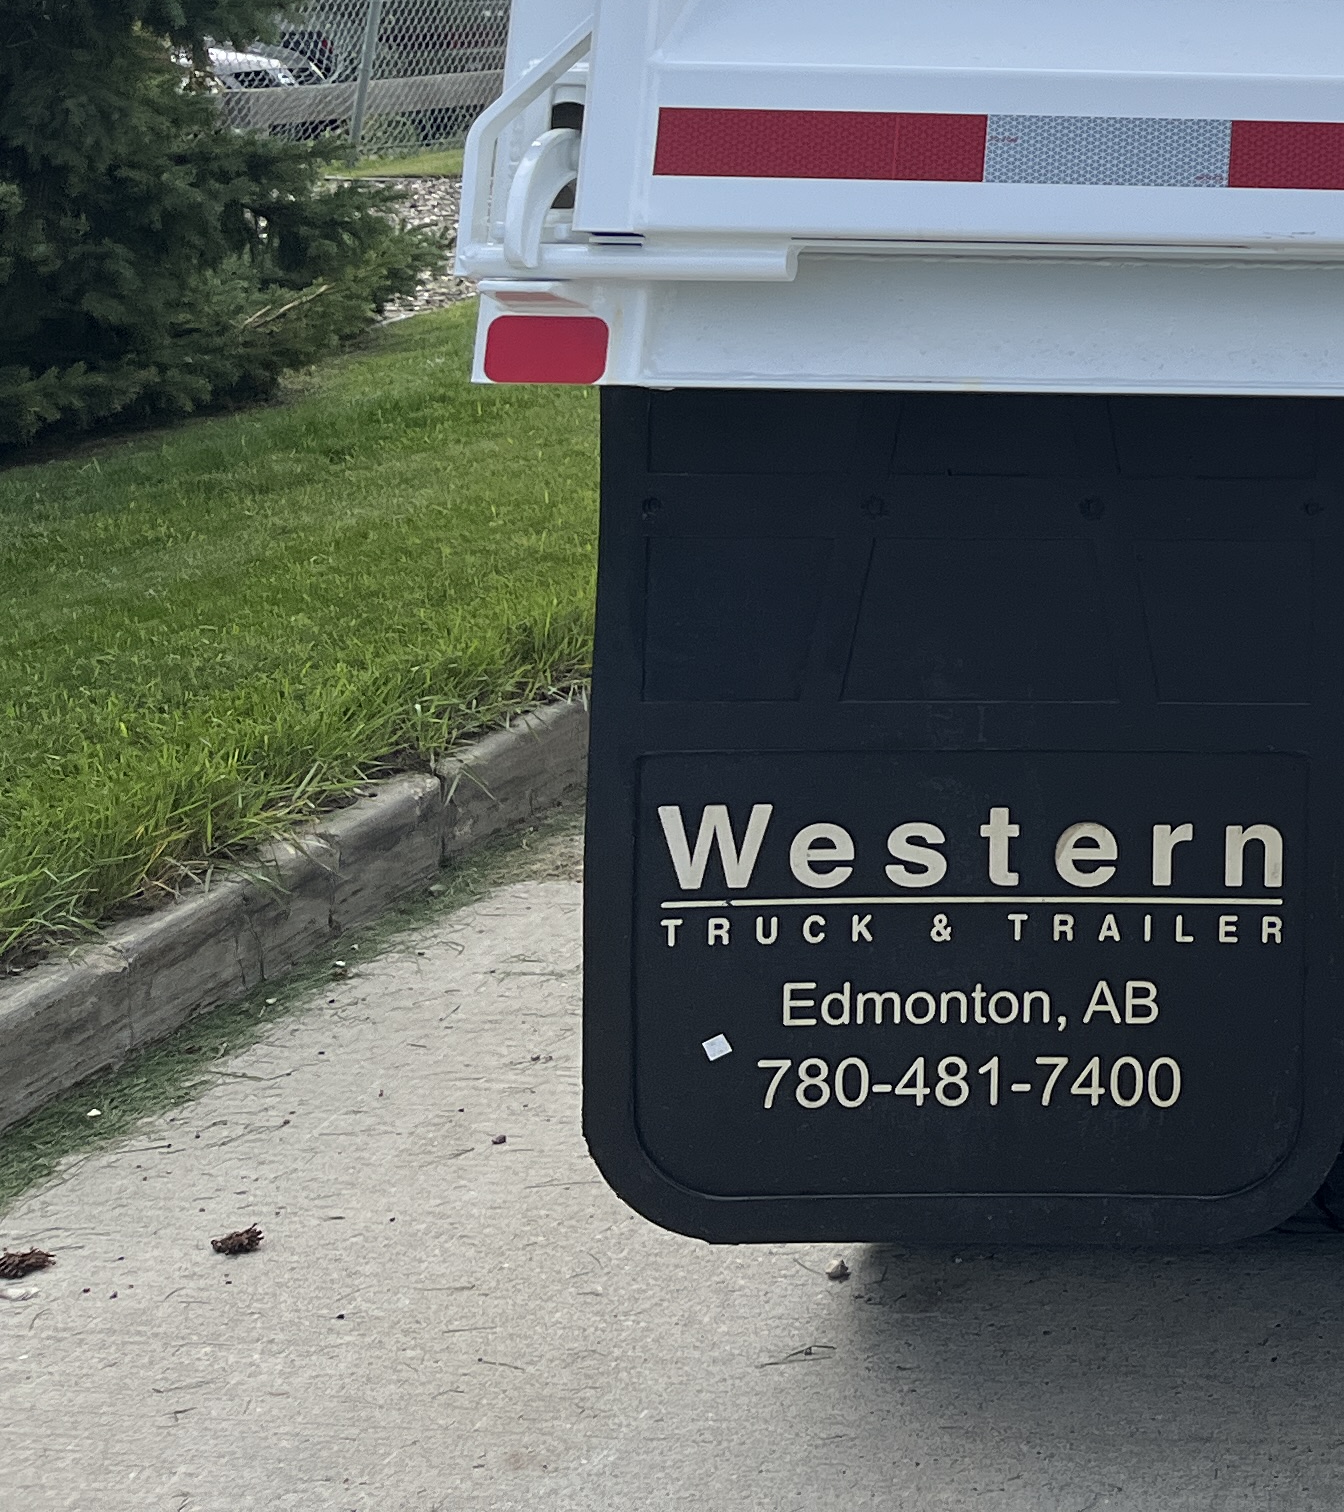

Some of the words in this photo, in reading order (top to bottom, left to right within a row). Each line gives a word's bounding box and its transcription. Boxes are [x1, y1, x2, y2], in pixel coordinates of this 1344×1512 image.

[657, 803, 1284, 890] Western
[660, 913, 875, 947] TRUCK
[930, 913, 953, 943] &
[1007, 912, 1284, 945] TRAILER
[781, 980, 1068, 1032] Edmonton,
[1082, 980, 1159, 1025] AB
[757, 1054, 1183, 1110] 780-481-7400
